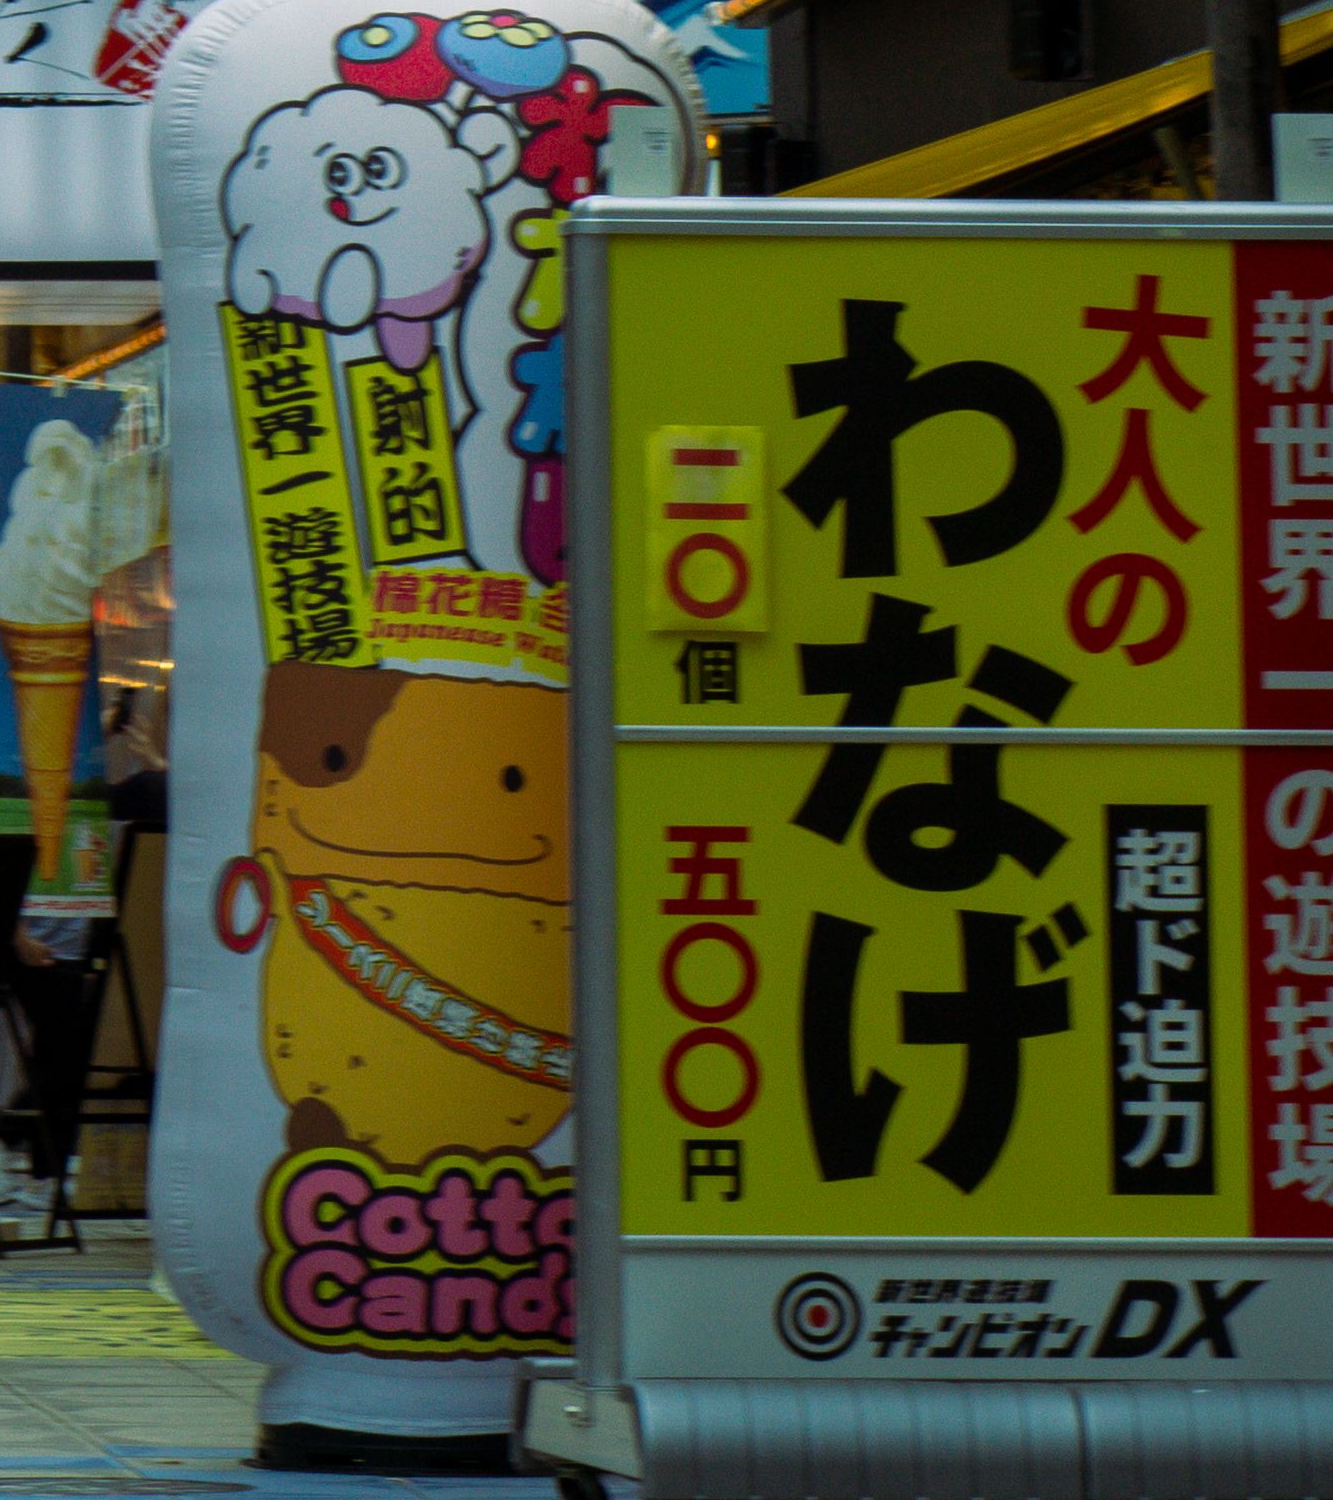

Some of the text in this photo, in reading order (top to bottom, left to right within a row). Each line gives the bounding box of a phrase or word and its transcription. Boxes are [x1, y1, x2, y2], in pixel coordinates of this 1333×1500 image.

[235, 314, 359, 666] 新世界一遊技場
[372, 375, 447, 548] 射的
[1065, 274, 1215, 668] 大人の
[782, 297, 1089, 1196] わなげ
[1252, 288, 1333, 1207] 新世界一の遊技場
[659, 825, 763, 1203] 五〇〇円
[1114, 828, 1211, 1170] 超ド迫力
[870, 1279, 1270, 1359] チャンピオン DX
